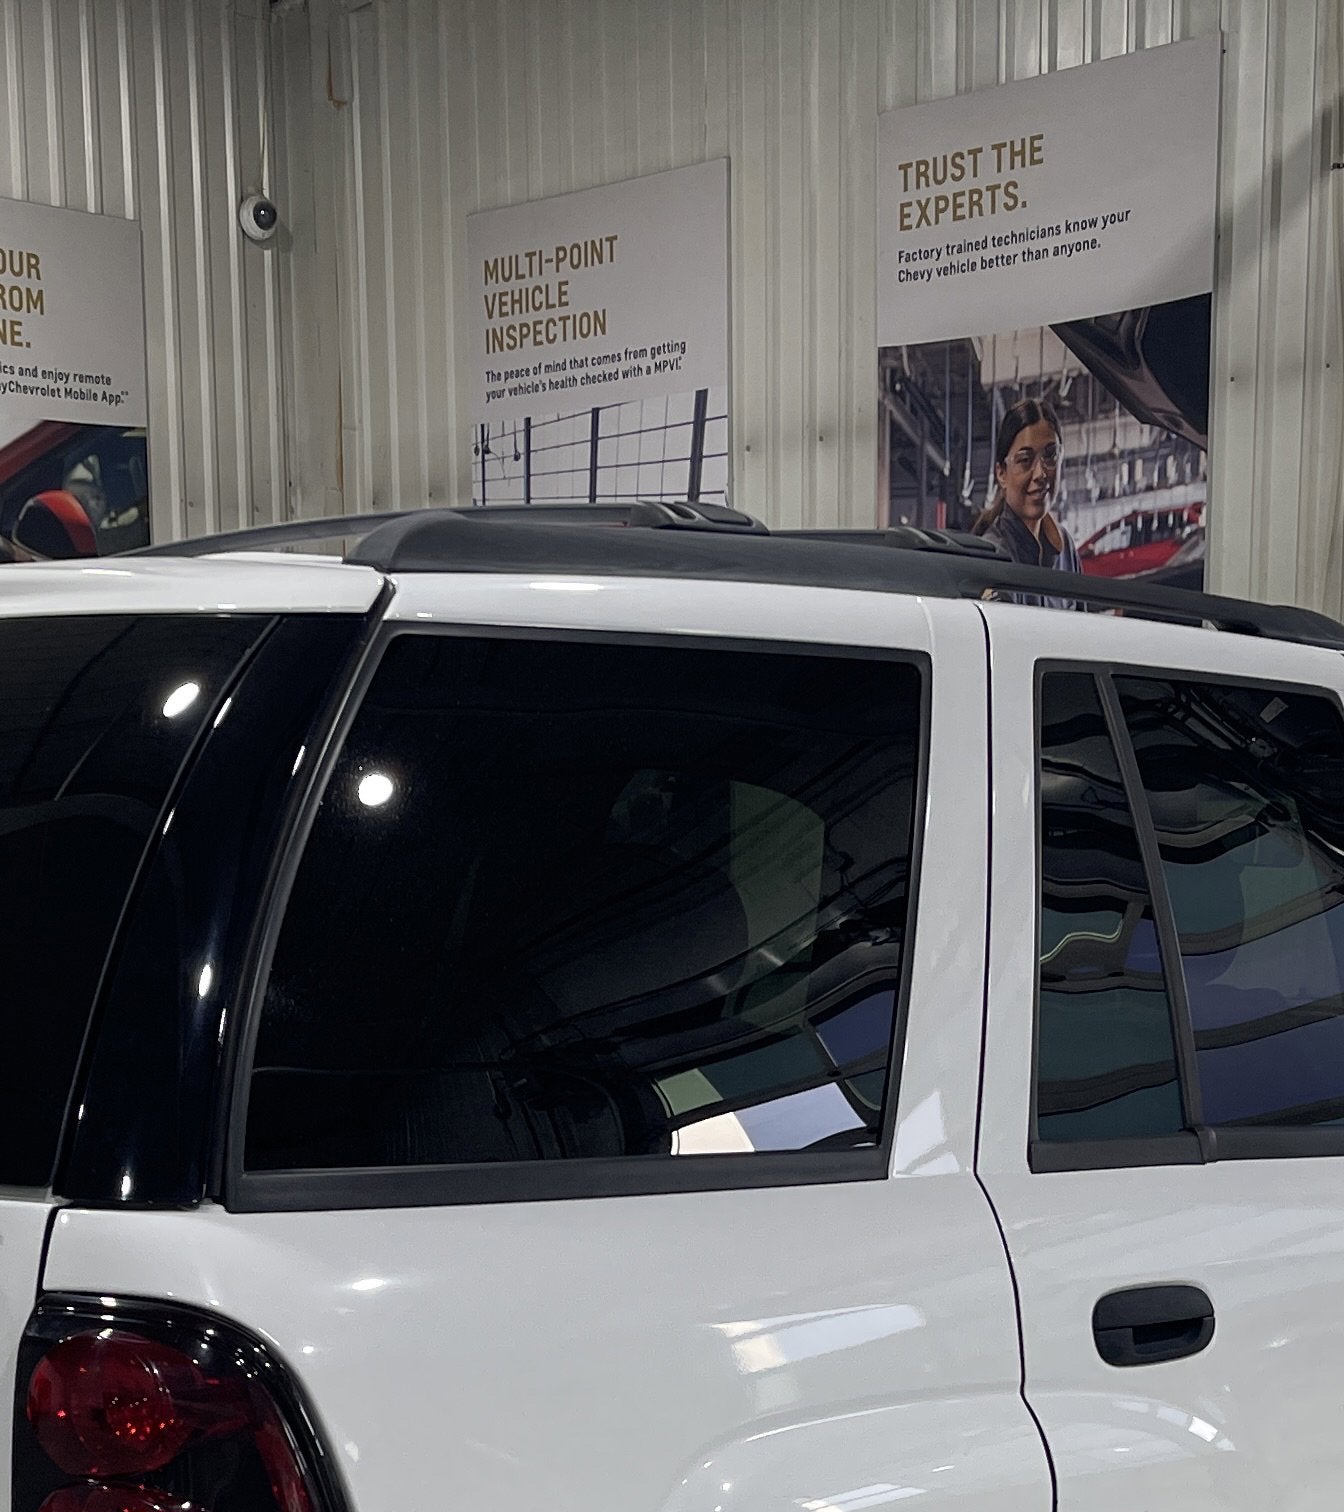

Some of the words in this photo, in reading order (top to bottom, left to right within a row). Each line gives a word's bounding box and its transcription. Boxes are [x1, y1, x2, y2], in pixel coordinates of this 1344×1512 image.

[898, 147, 984, 193] TRUST
[991, 133, 1044, 174] THE
[899, 180, 1028, 232] EXPERTS.
[898, 246, 943, 263] Factory
[946, 235, 988, 256] trained
[991, 223, 1062, 248] technicians
[1064, 216, 1099, 234] know
[1101, 209, 1131, 231] your
[484, 234, 619, 286] MULTI-POINT
[898, 267, 933, 283] Chevy
[936, 258, 977, 278] vehicle
[980, 252, 1019, 270] better
[1021, 247, 1049, 263] than
[1052, 237, 1101, 258] anyone.
[484, 280, 570, 320] VEHICLE
[485, 308, 607, 354] INSPECTION
[18, 366, 38, 378] and
[41, 368, 70, 384] enjoy
[73, 373, 111, 386] remote
[485, 370, 502, 383] The
[504, 367, 530, 384] peace
[532, 362, 542, 376] of
[544, 358, 567, 374] mind
[569, 356, 589, 370] that
[591, 352, 622, 367] comes
[624, 347, 648, 360] from
[650, 340, 686, 360] getting
[485, 388, 506, 404] your
[508, 380, 547, 397] vehicle's
[548, 375, 578, 391] health
[580, 368, 619, 386] checked
[622, 364, 643, 380] with
[646, 365, 652, 376] a
[64, 387, 98, 401] Mobile
